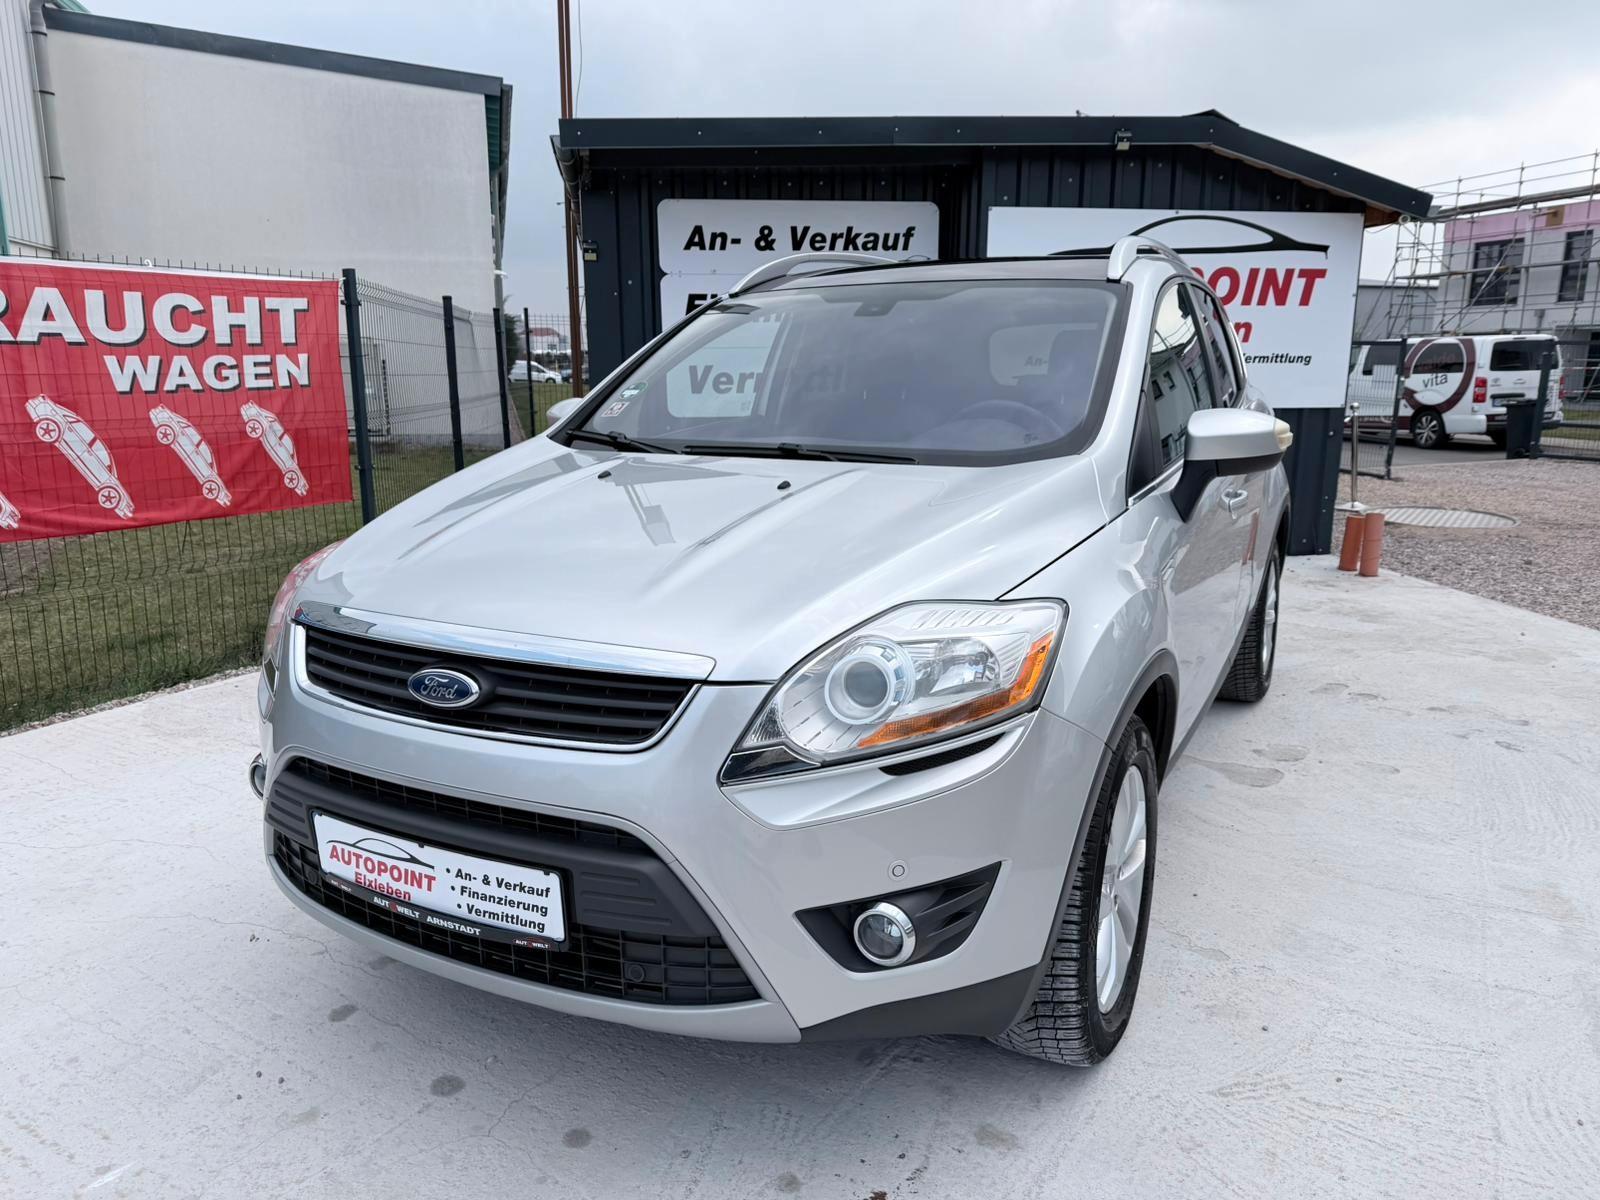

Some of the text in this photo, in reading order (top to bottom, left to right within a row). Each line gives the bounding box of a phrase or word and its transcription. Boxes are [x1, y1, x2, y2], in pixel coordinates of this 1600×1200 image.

[683, 225, 916, 251] An- & Verkauf
[1191, 266, 1328, 307] OINT
[103, 352, 311, 393] WAGEN
[1242, 352, 1312, 366] ermittlung
[1422, 372, 1448, 388] vita
[420, 675, 459, 699] Ford
[329, 844, 436, 892] AUTOPOINT
[455, 868, 551, 898] An- & Verkauf
[460, 885, 548, 917] Finanzierung
[426, 915, 481, 936] ARNSTADT
[466, 903, 545, 934] Vermittlung
